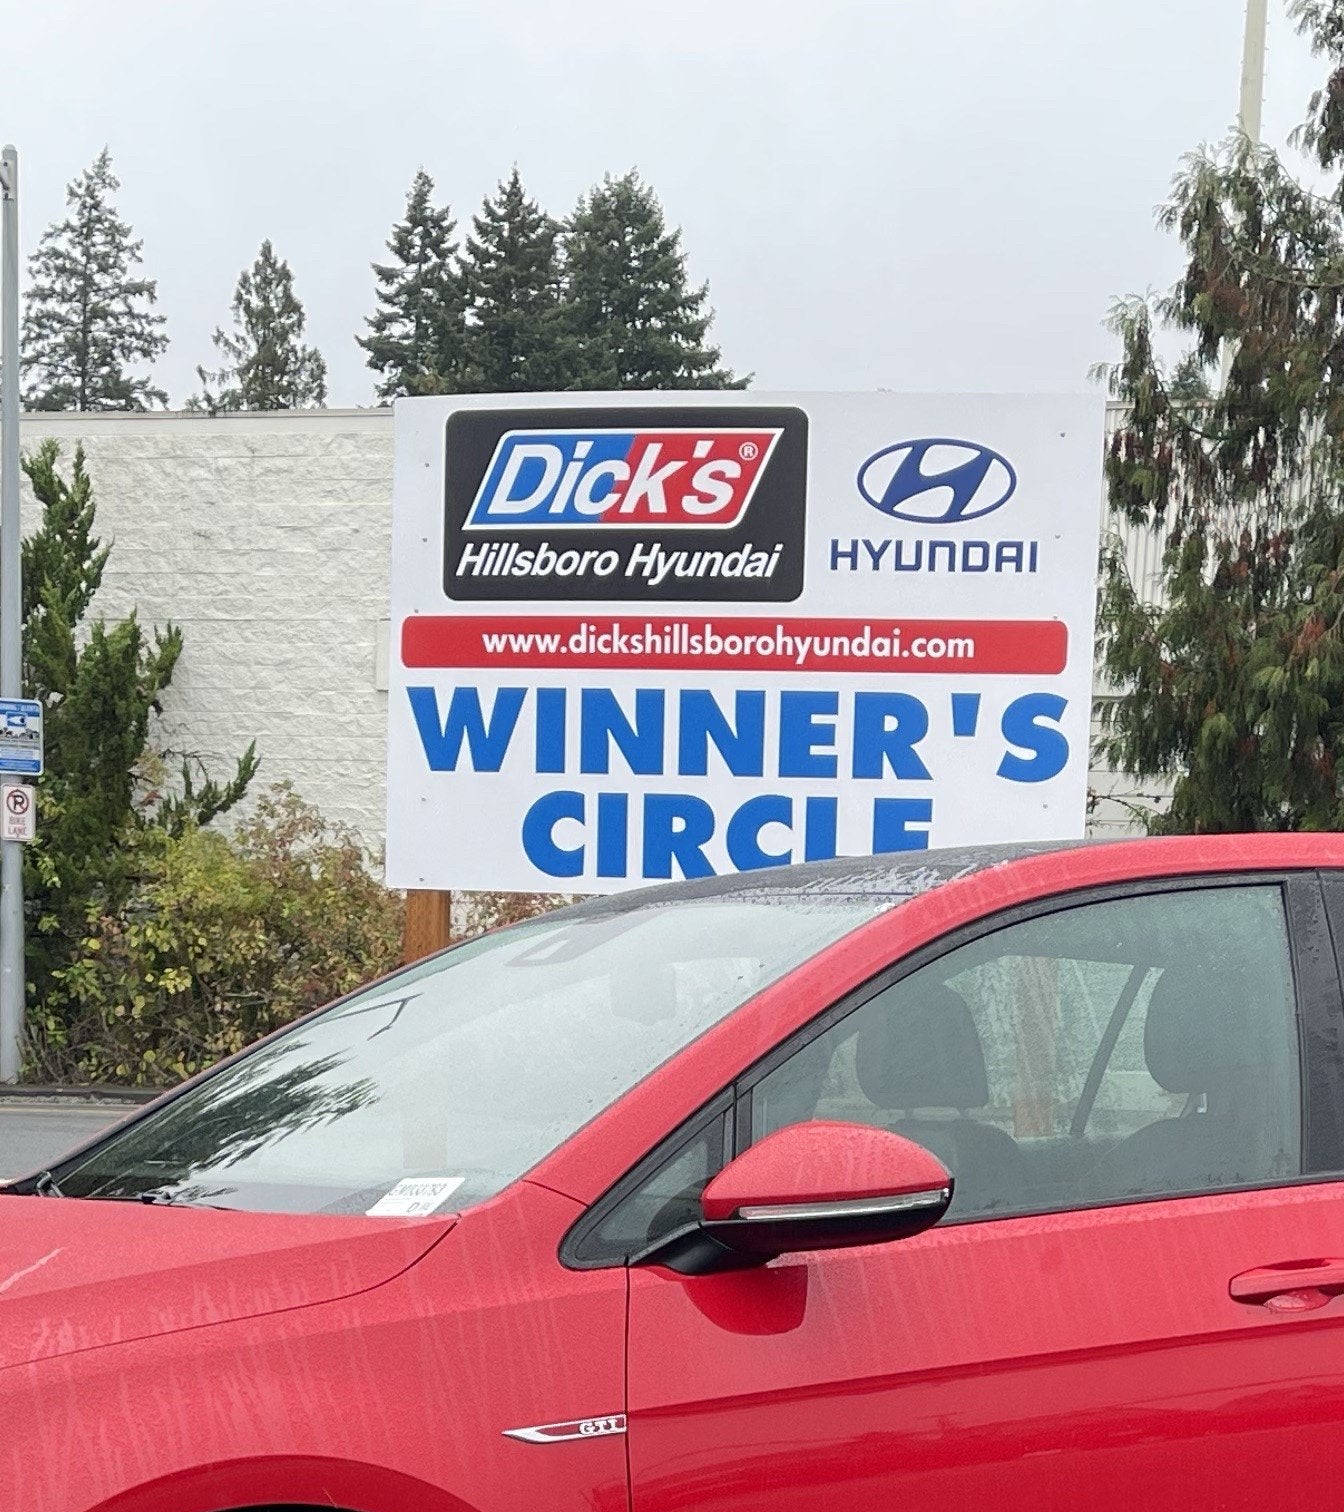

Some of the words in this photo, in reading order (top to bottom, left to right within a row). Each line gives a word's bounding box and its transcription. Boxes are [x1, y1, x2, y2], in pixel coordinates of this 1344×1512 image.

[456, 542, 619, 578] Hillsboro
[624, 542, 785, 586] Hyundai
[830, 539, 1038, 573] HYUNDAI
[482, 625, 975, 661] www.dickshillsborohyundai.com
[406, 686, 1069, 783] WINNER'S
[522, 790, 933, 879] CIRCLE
[579, 1418, 618, 1436] GTI
